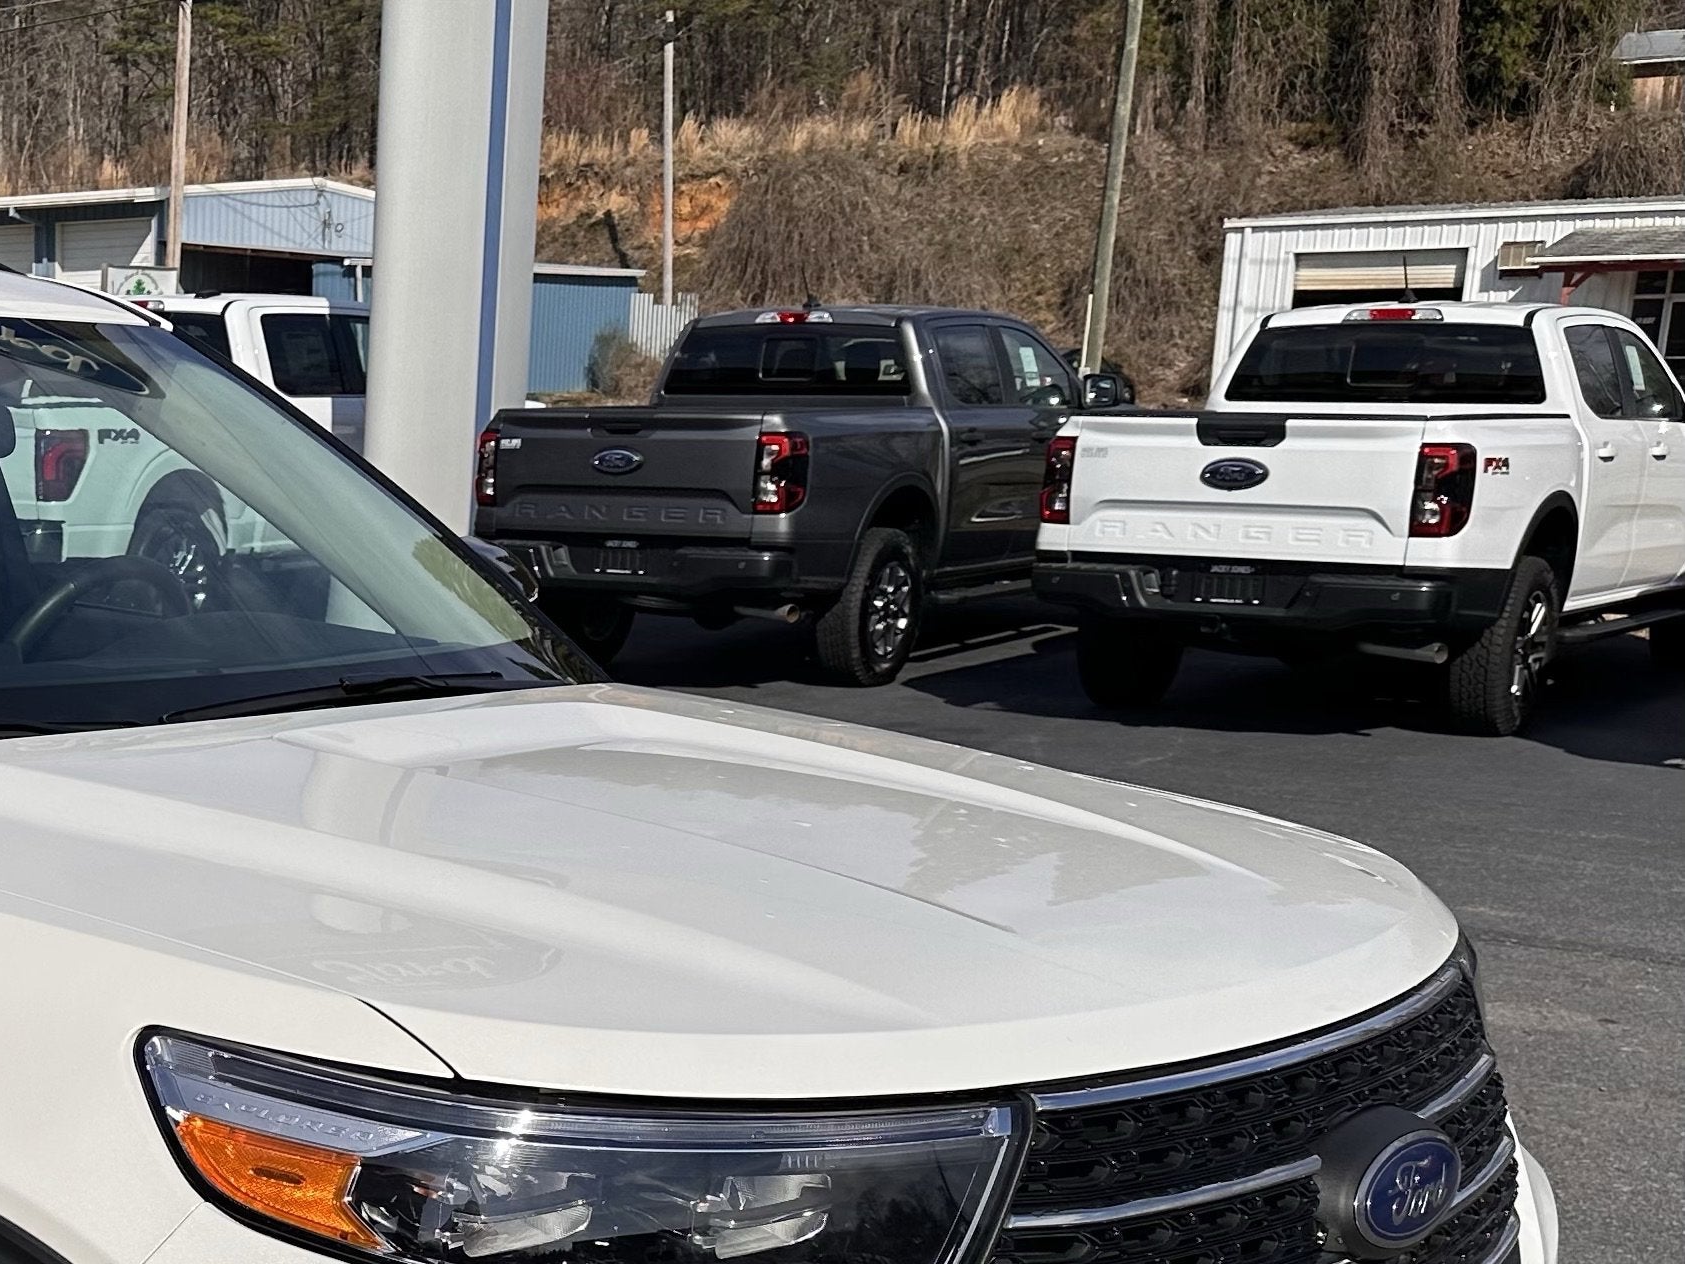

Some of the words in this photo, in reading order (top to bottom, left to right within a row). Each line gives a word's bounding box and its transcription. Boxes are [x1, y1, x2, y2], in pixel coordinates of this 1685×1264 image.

[98, 428, 140, 445] FX4
[1483, 457, 1510, 473] FX4
[515, 503, 725, 525] RANGER
[1094, 519, 1375, 548] RANGER
[1387, 1155, 1448, 1226] Ford
